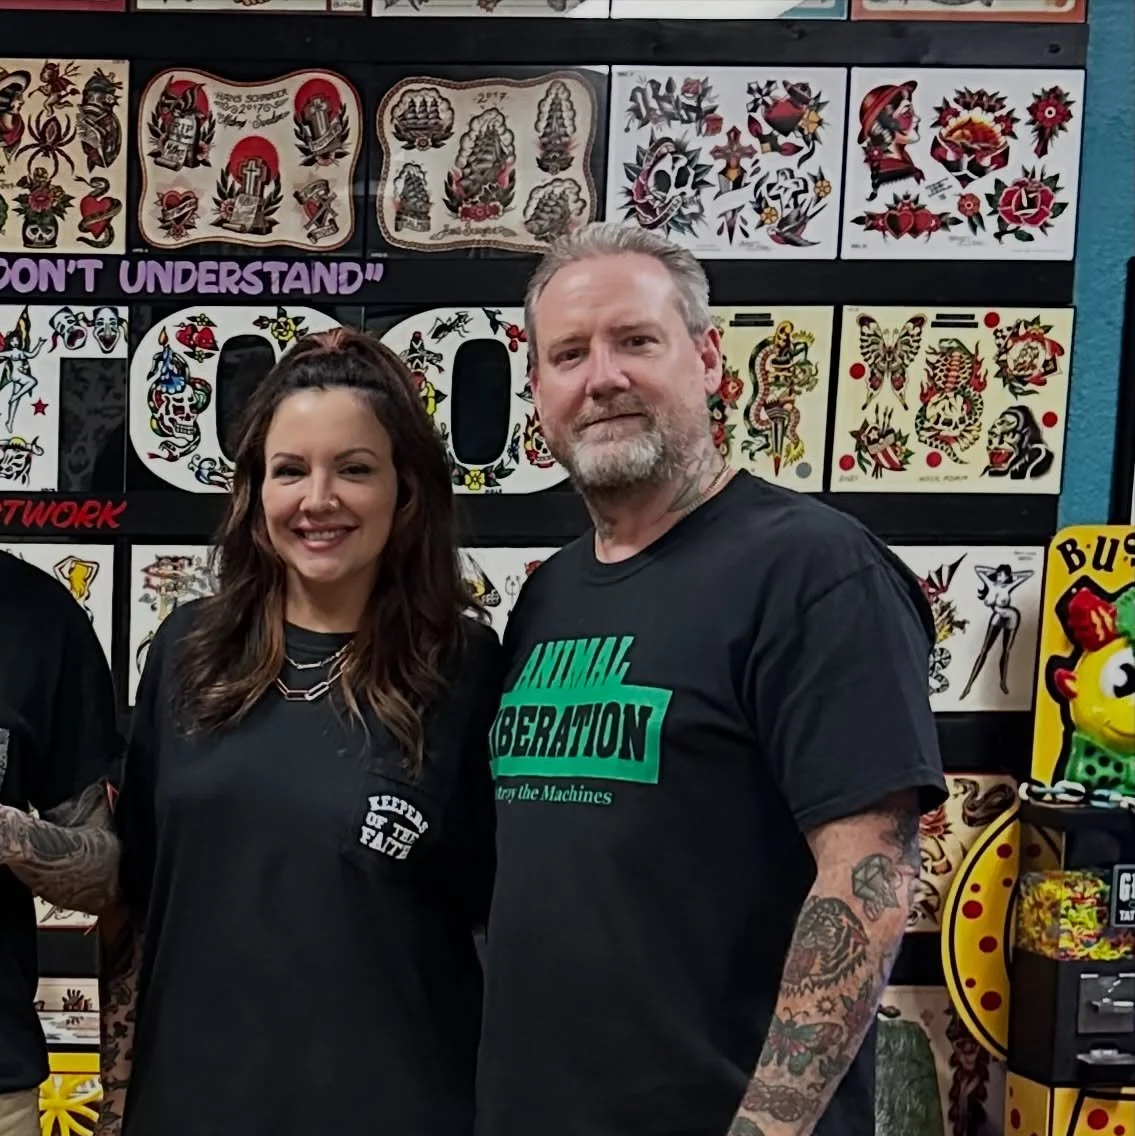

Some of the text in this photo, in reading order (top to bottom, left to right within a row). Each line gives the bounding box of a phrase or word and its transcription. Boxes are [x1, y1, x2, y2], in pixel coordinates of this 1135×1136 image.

[119, 259, 384, 295] UNDERSTAND"
[513, 635, 635, 690] ANIMAL
[491, 701, 654, 763] IBERATION
[517, 783, 540, 801] the
[540, 784, 613, 805] Machines
[365, 811, 420, 844] OF THE
[368, 795, 429, 834] KEEPERS
[359, 826, 412, 860] FAITH
